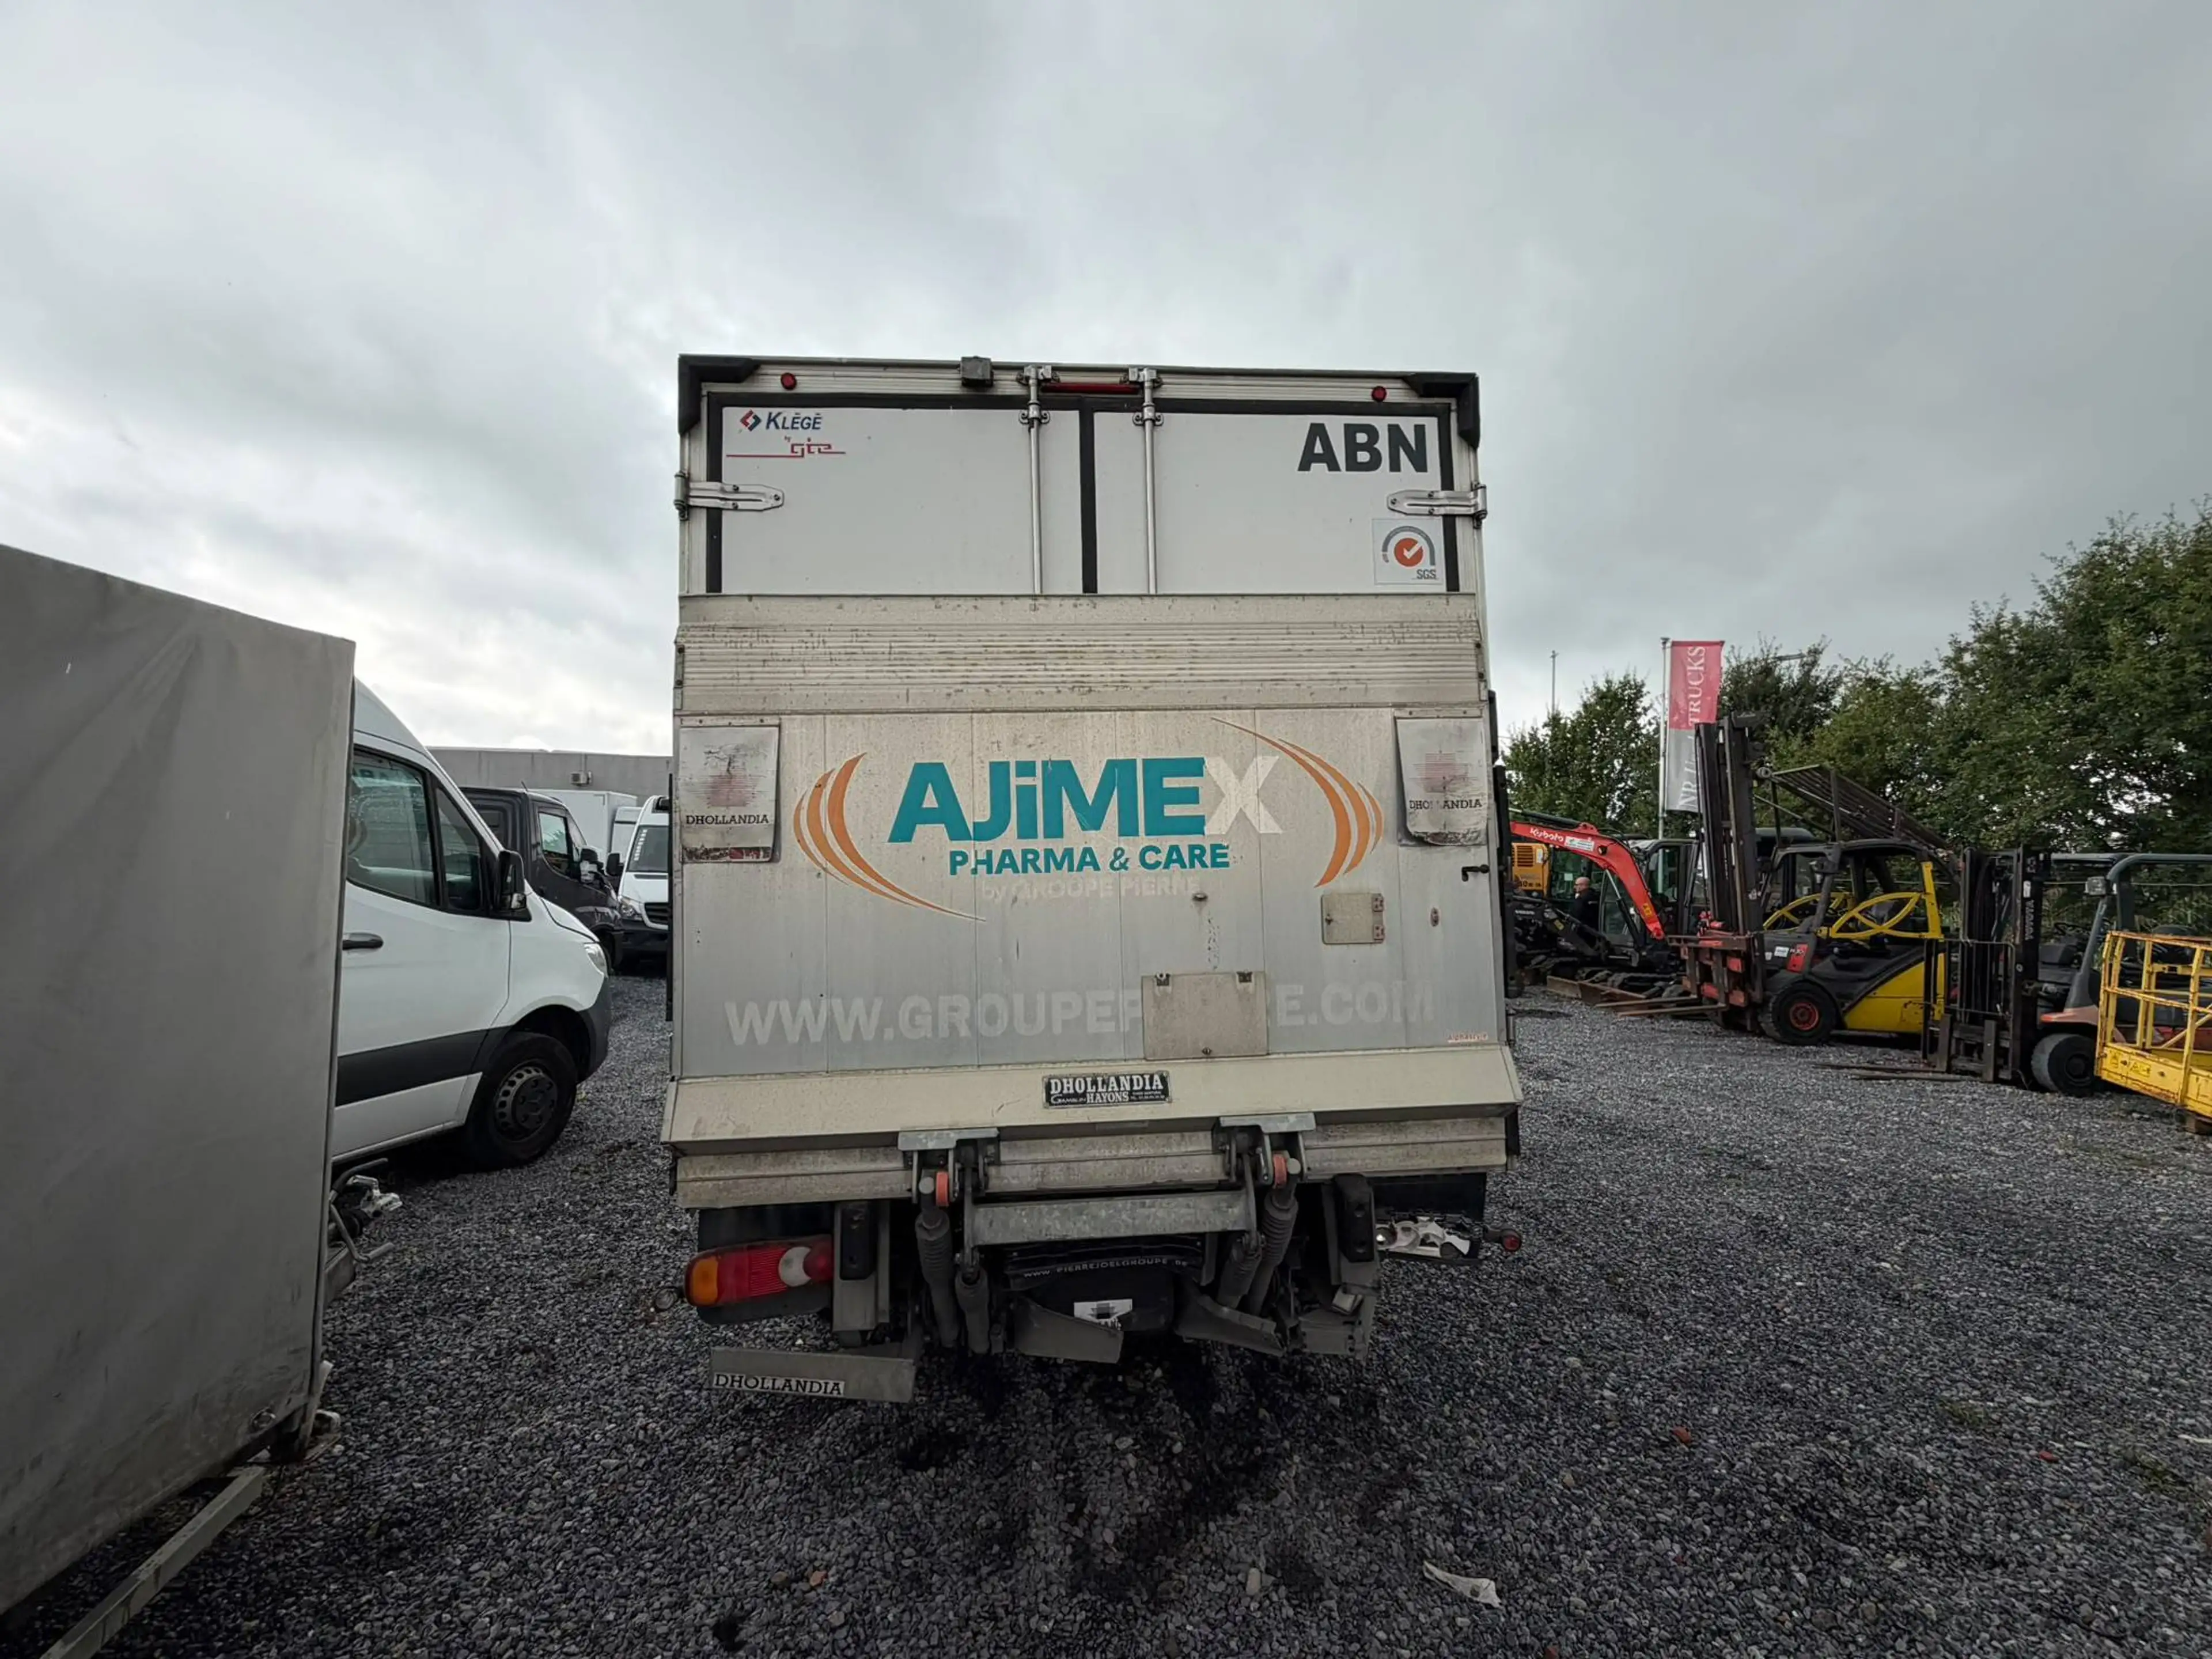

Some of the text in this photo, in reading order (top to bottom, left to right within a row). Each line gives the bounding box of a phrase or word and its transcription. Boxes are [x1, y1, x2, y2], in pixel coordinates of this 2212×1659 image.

[1297, 423, 1428, 473] ABN
[1416, 569, 1437, 579] SGS
[1687, 646, 1706, 726] TRUCKS
[1409, 799, 1482, 810] DHOANDIA
[685, 815, 770, 825] DHOLLANDIA
[949, 843, 1230, 876] PHARMA & CARE
[1050, 1075, 1163, 1094] DHOLLANDIA
[1086, 1092, 1130, 1104] HAYONS
[715, 1374, 842, 1395] DHOLLANDIA
